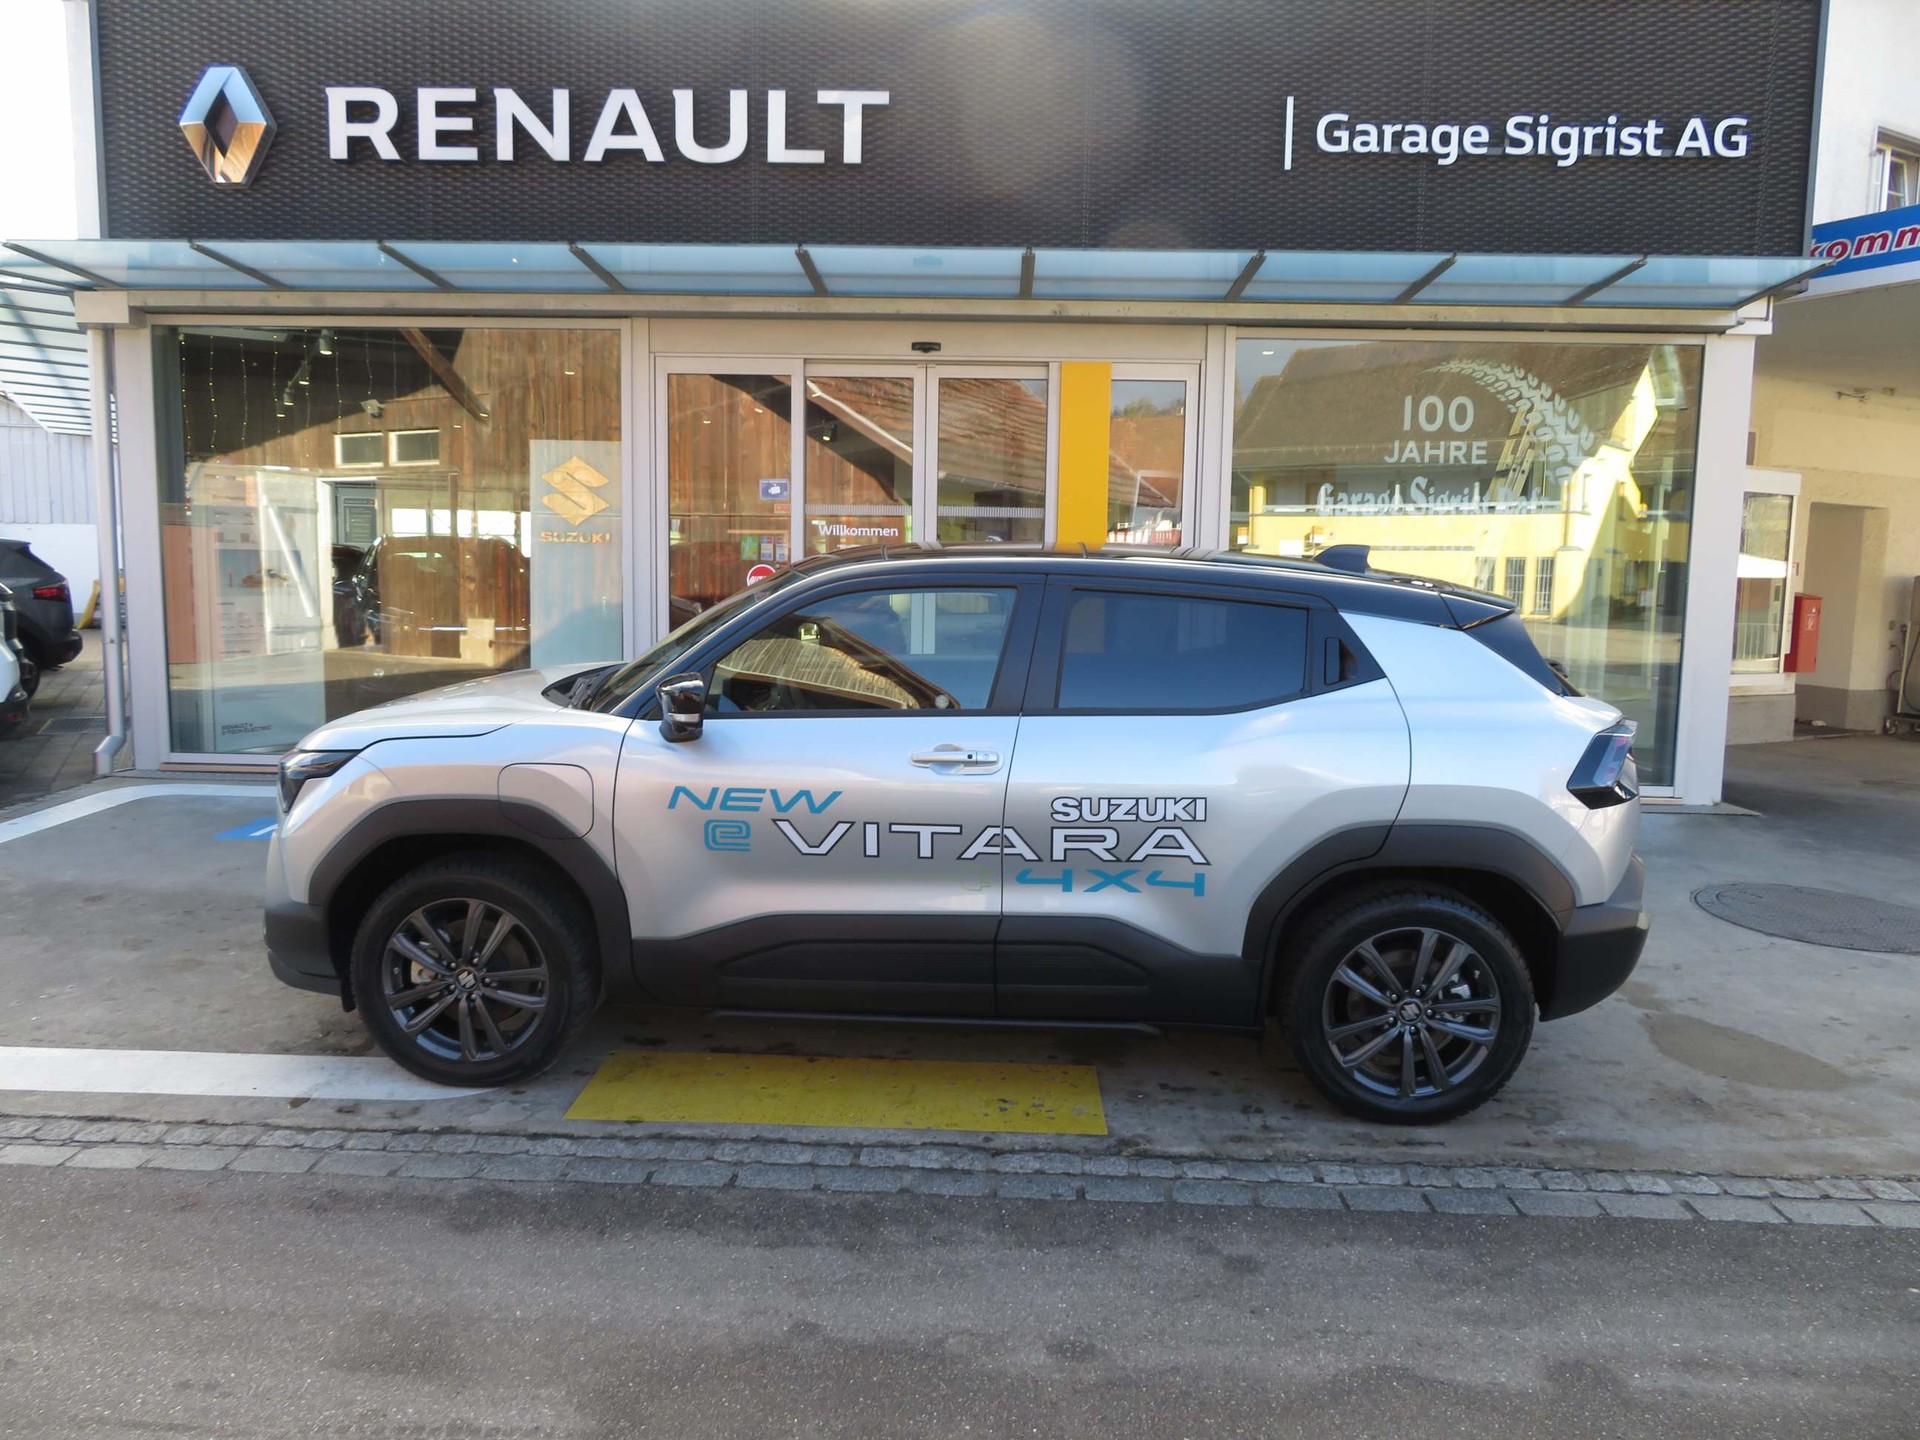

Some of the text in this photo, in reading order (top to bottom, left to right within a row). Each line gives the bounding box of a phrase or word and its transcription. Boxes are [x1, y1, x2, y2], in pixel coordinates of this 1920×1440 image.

[325, 87, 890, 164] RENAULT
[1316, 113, 1749, 167] Garage Sigrist AG
[1402, 395, 1475, 433] 100
[1383, 440, 1488, 465] JAHRE
[1409, 476, 1491, 516] Sigrist
[540, 531, 612, 544] SUZUKI
[818, 524, 899, 537] Willkommen
[667, 785, 843, 814] NEW
[1051, 796, 1207, 822] SUZUKI
[770, 818, 1212, 866] VITARA
